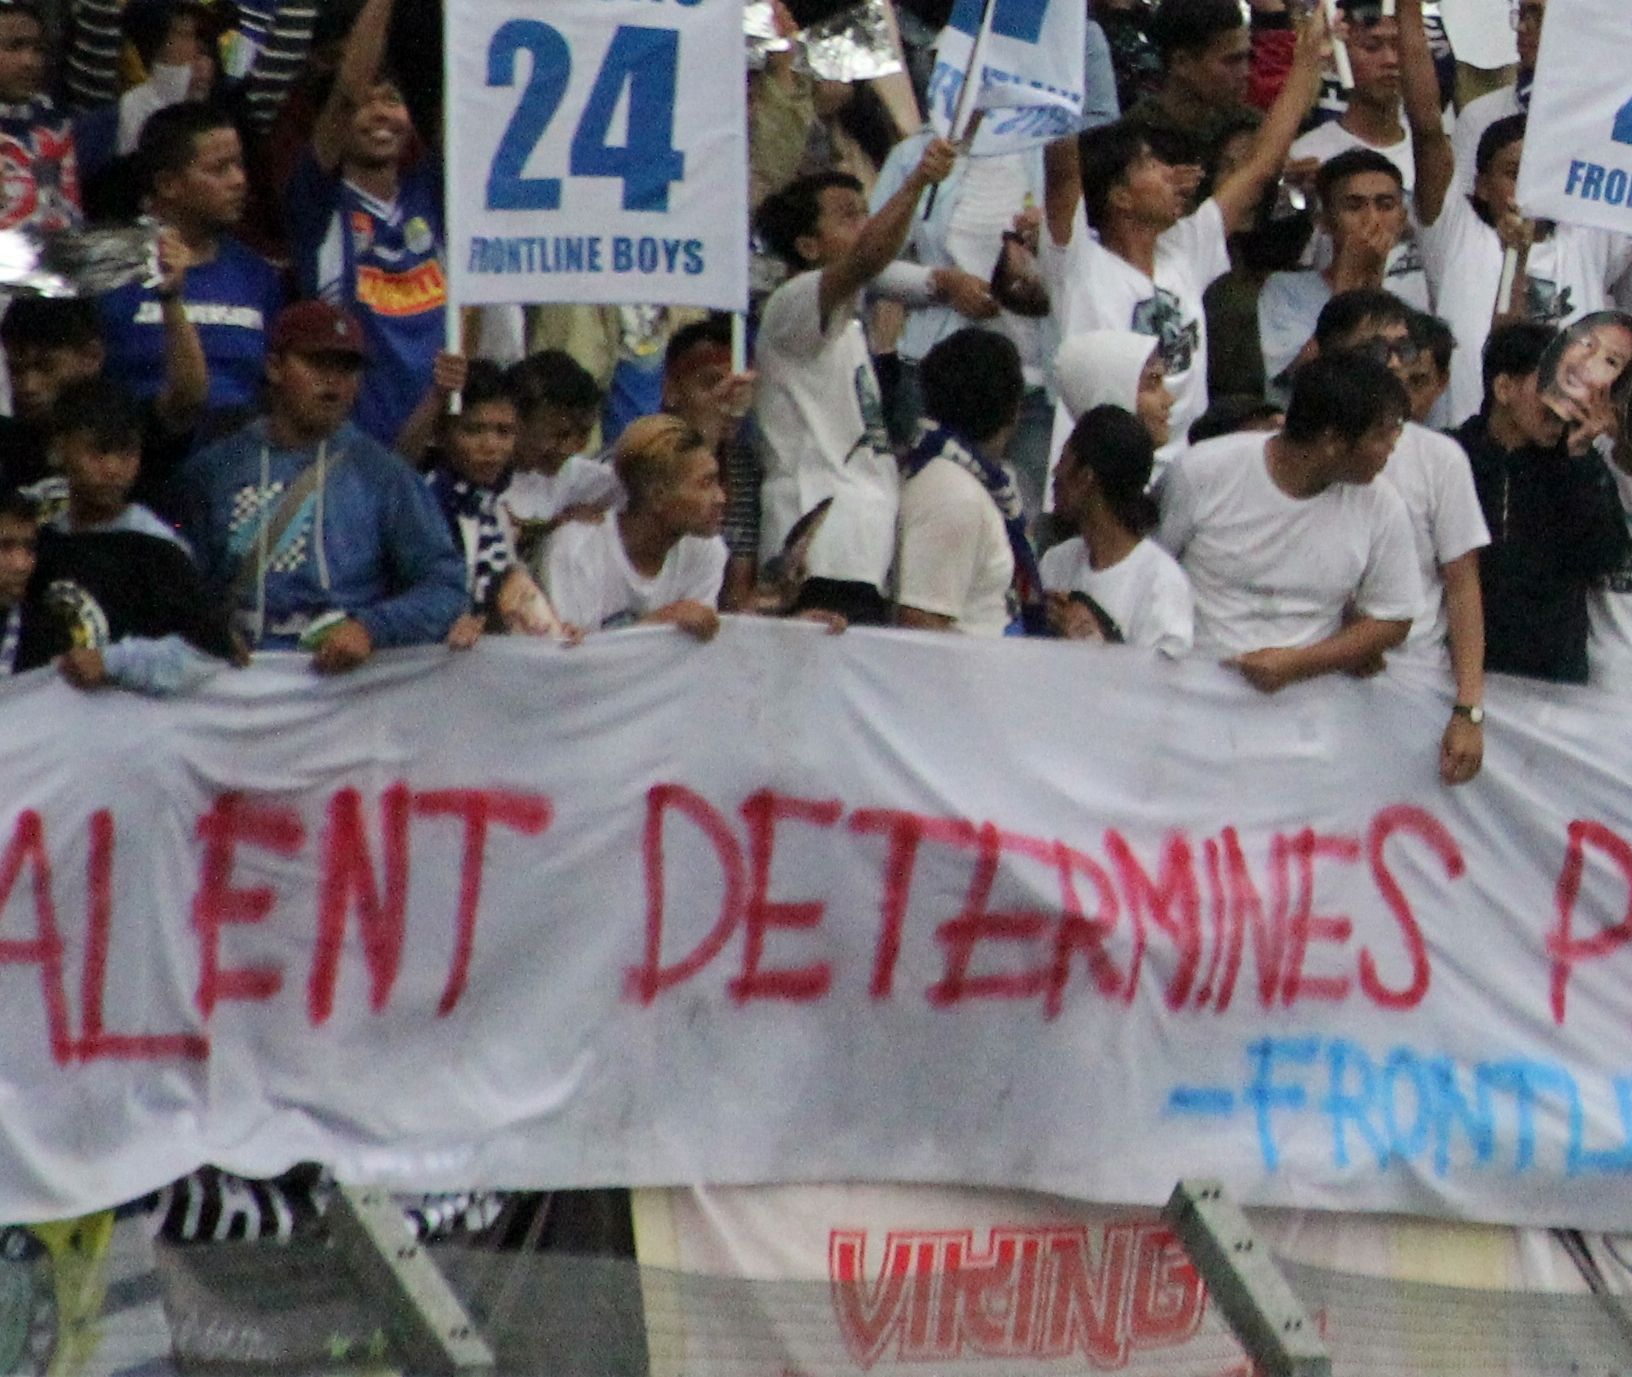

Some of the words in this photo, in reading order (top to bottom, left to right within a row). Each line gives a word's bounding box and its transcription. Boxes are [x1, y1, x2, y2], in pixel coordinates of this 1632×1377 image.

[484, 17, 687, 215] 24
[467, 234, 605, 276] FRONTLINE
[613, 239, 706, 278] BOYS
[620, 782, 1466, 1020] DETERMINES
[828, 1226, 1208, 1371] VIKING
